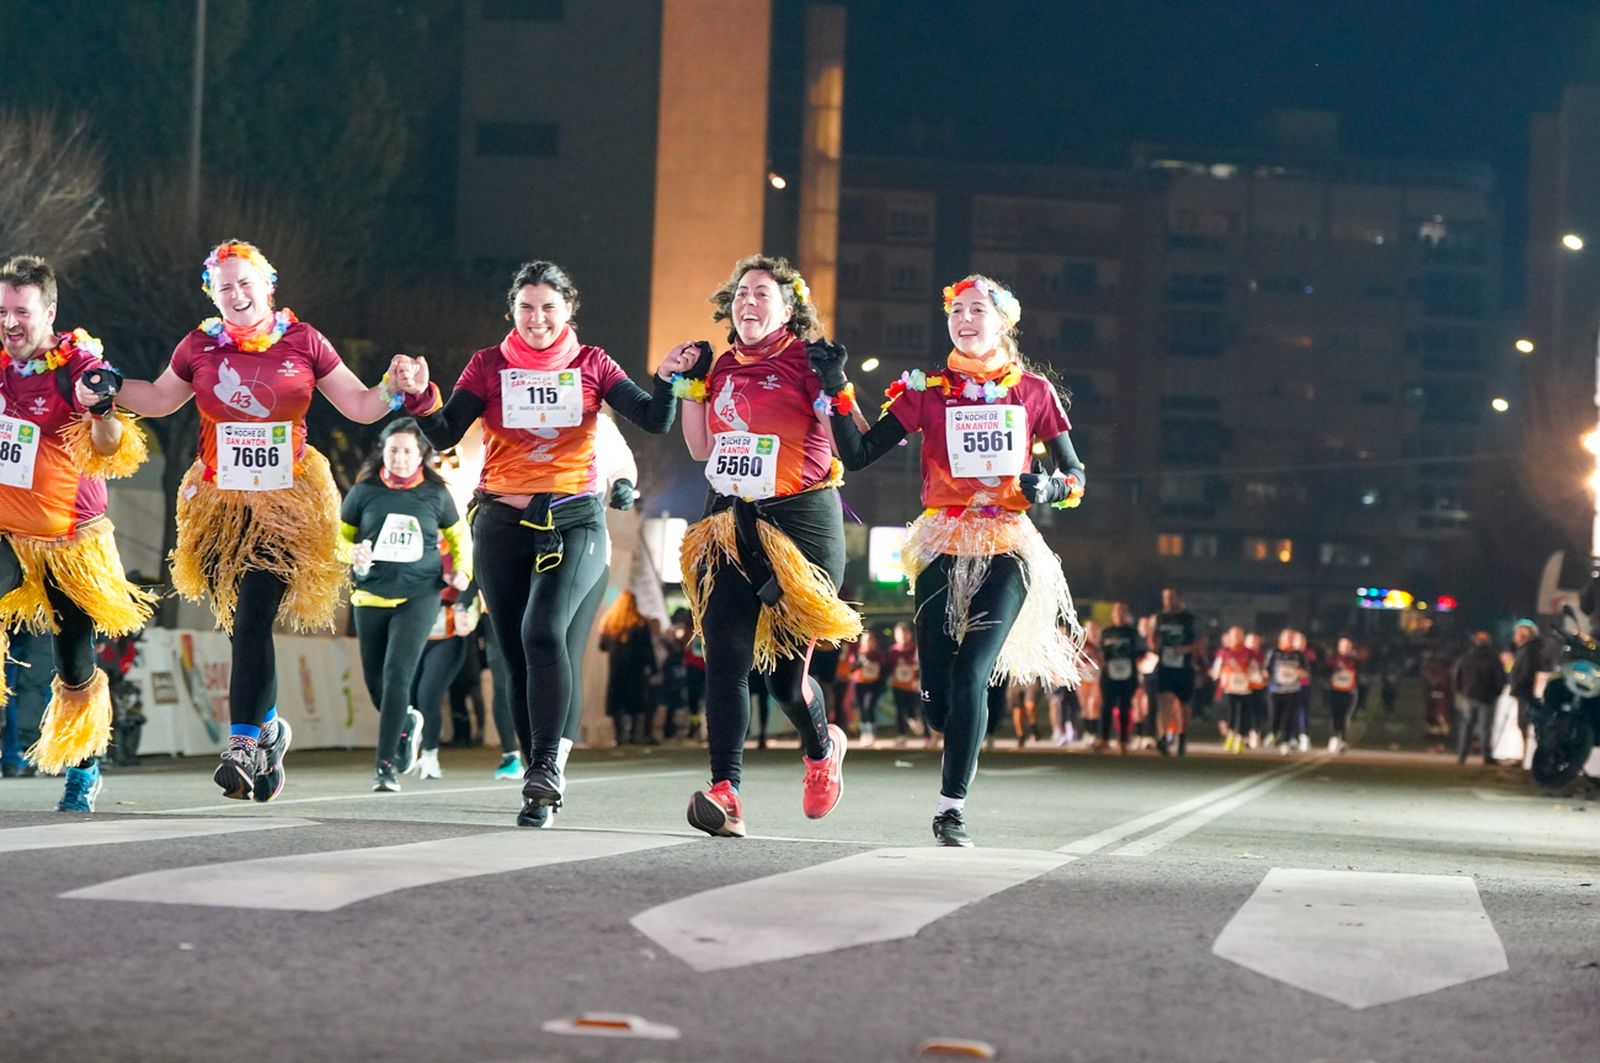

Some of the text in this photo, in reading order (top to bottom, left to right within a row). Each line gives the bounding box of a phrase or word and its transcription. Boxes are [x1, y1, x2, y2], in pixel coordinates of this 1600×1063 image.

[230, 391, 251, 409] 43
[526, 386, 558, 404] 115
[720, 404, 735, 422] 43
[964, 412, 998, 421] NOCHE DE
[955, 422, 971, 431] SAN
[226, 437, 241, 445] SAN
[963, 430, 1013, 453] 5561
[232, 446, 279, 467] 7666
[716, 455, 763, 477] 5560
